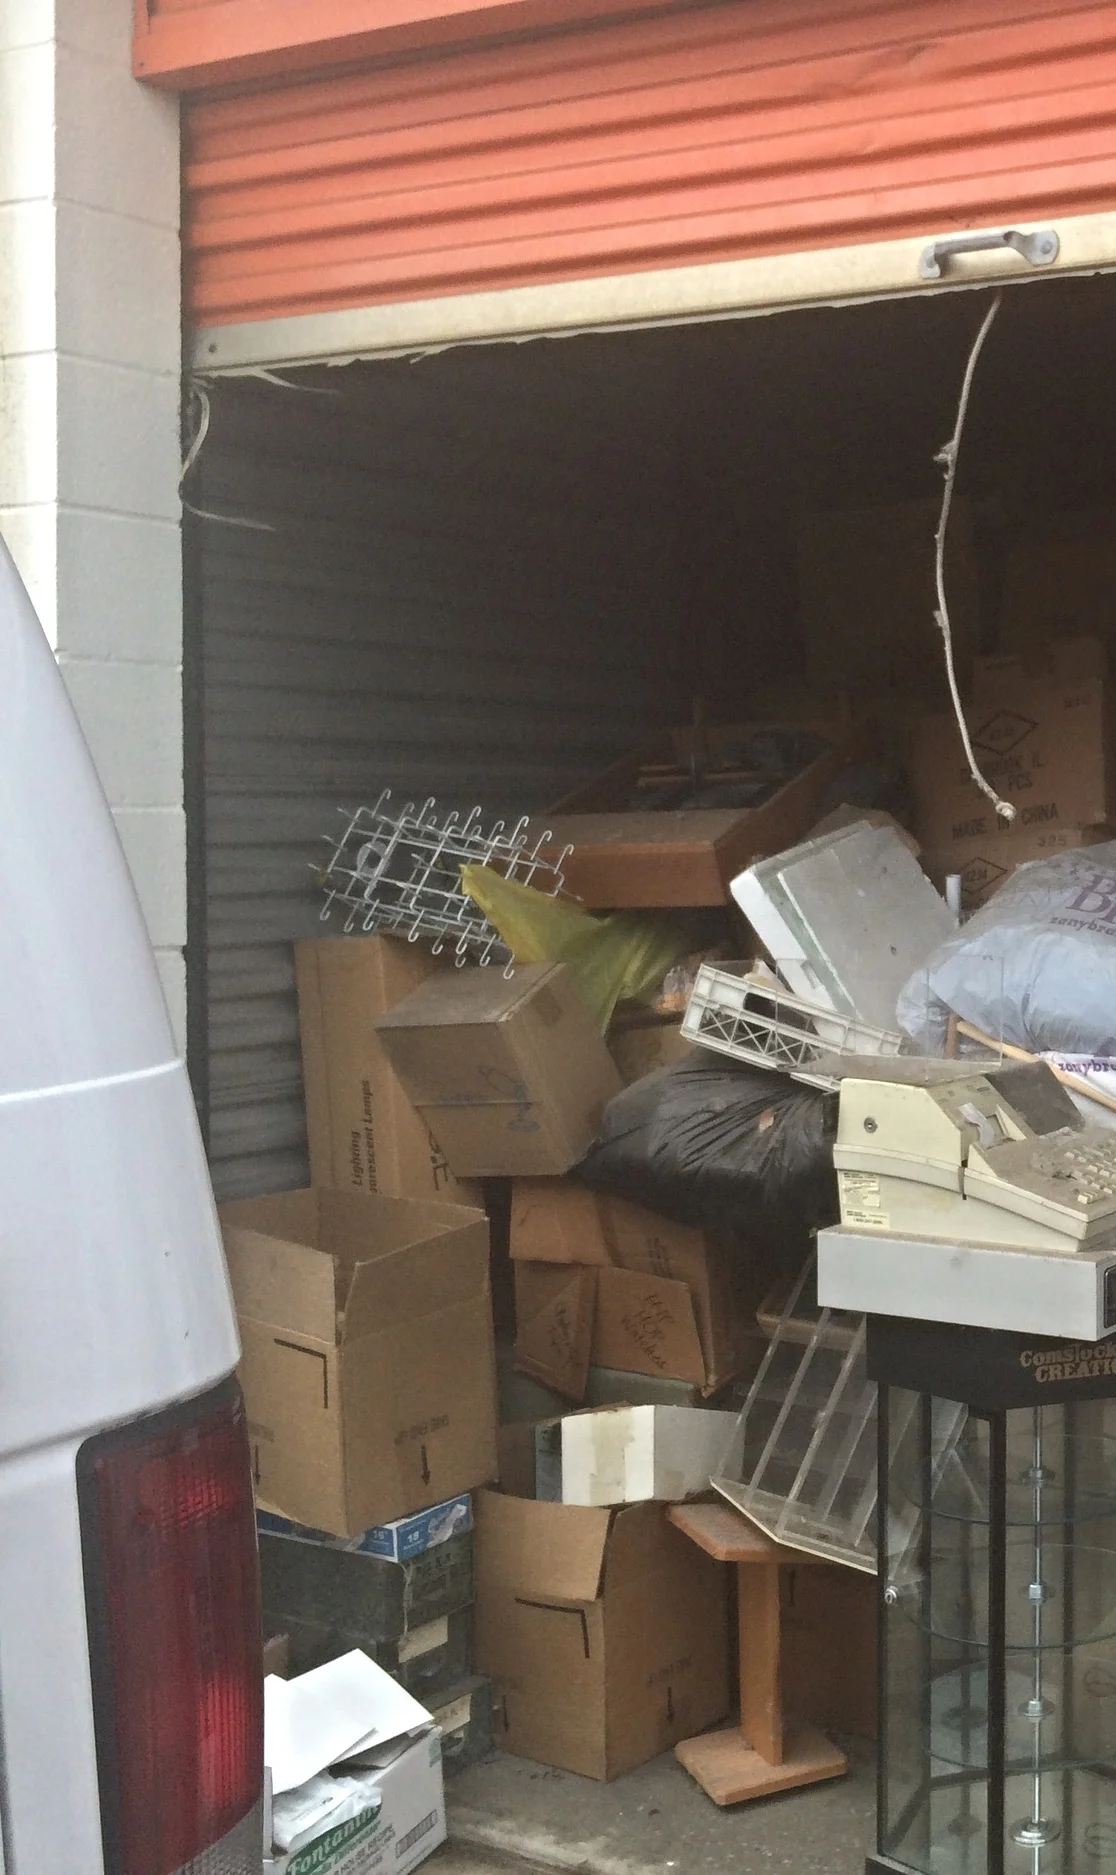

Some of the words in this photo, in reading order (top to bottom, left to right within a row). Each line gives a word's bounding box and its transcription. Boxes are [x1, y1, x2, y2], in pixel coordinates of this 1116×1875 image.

[1021, 803, 1058, 825] CHINA
[360, 1079, 373, 1123] Lamps
[350, 1130, 363, 1186] Lighting
